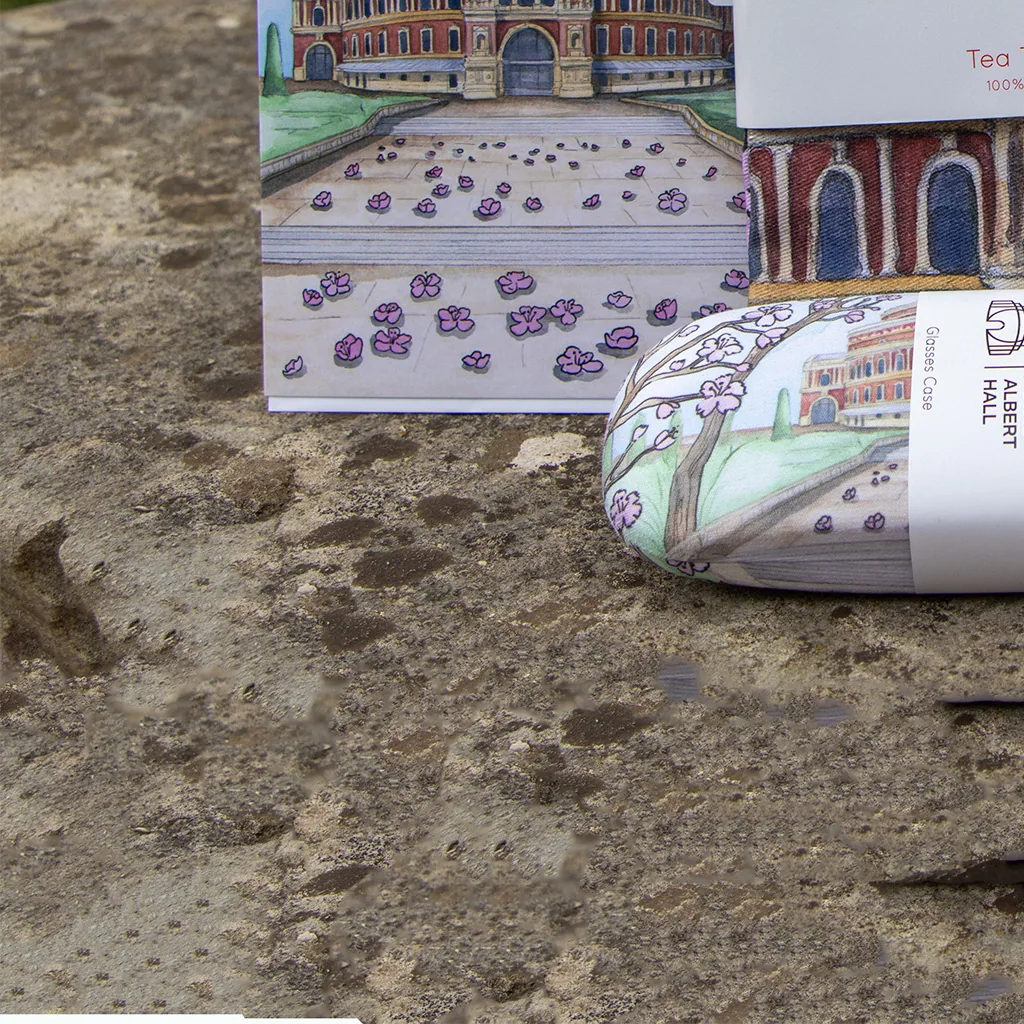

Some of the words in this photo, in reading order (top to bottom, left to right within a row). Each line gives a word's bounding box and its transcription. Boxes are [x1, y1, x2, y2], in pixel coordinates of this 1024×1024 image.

[966, 49, 1010, 69] Tea
[986, 78, 1024, 91] 100%
[924, 326, 940, 372] Glasses
[922, 376, 937, 411] Case
[982, 380, 997, 425] HALL
[1003, 379, 1017, 449] ALBERT
